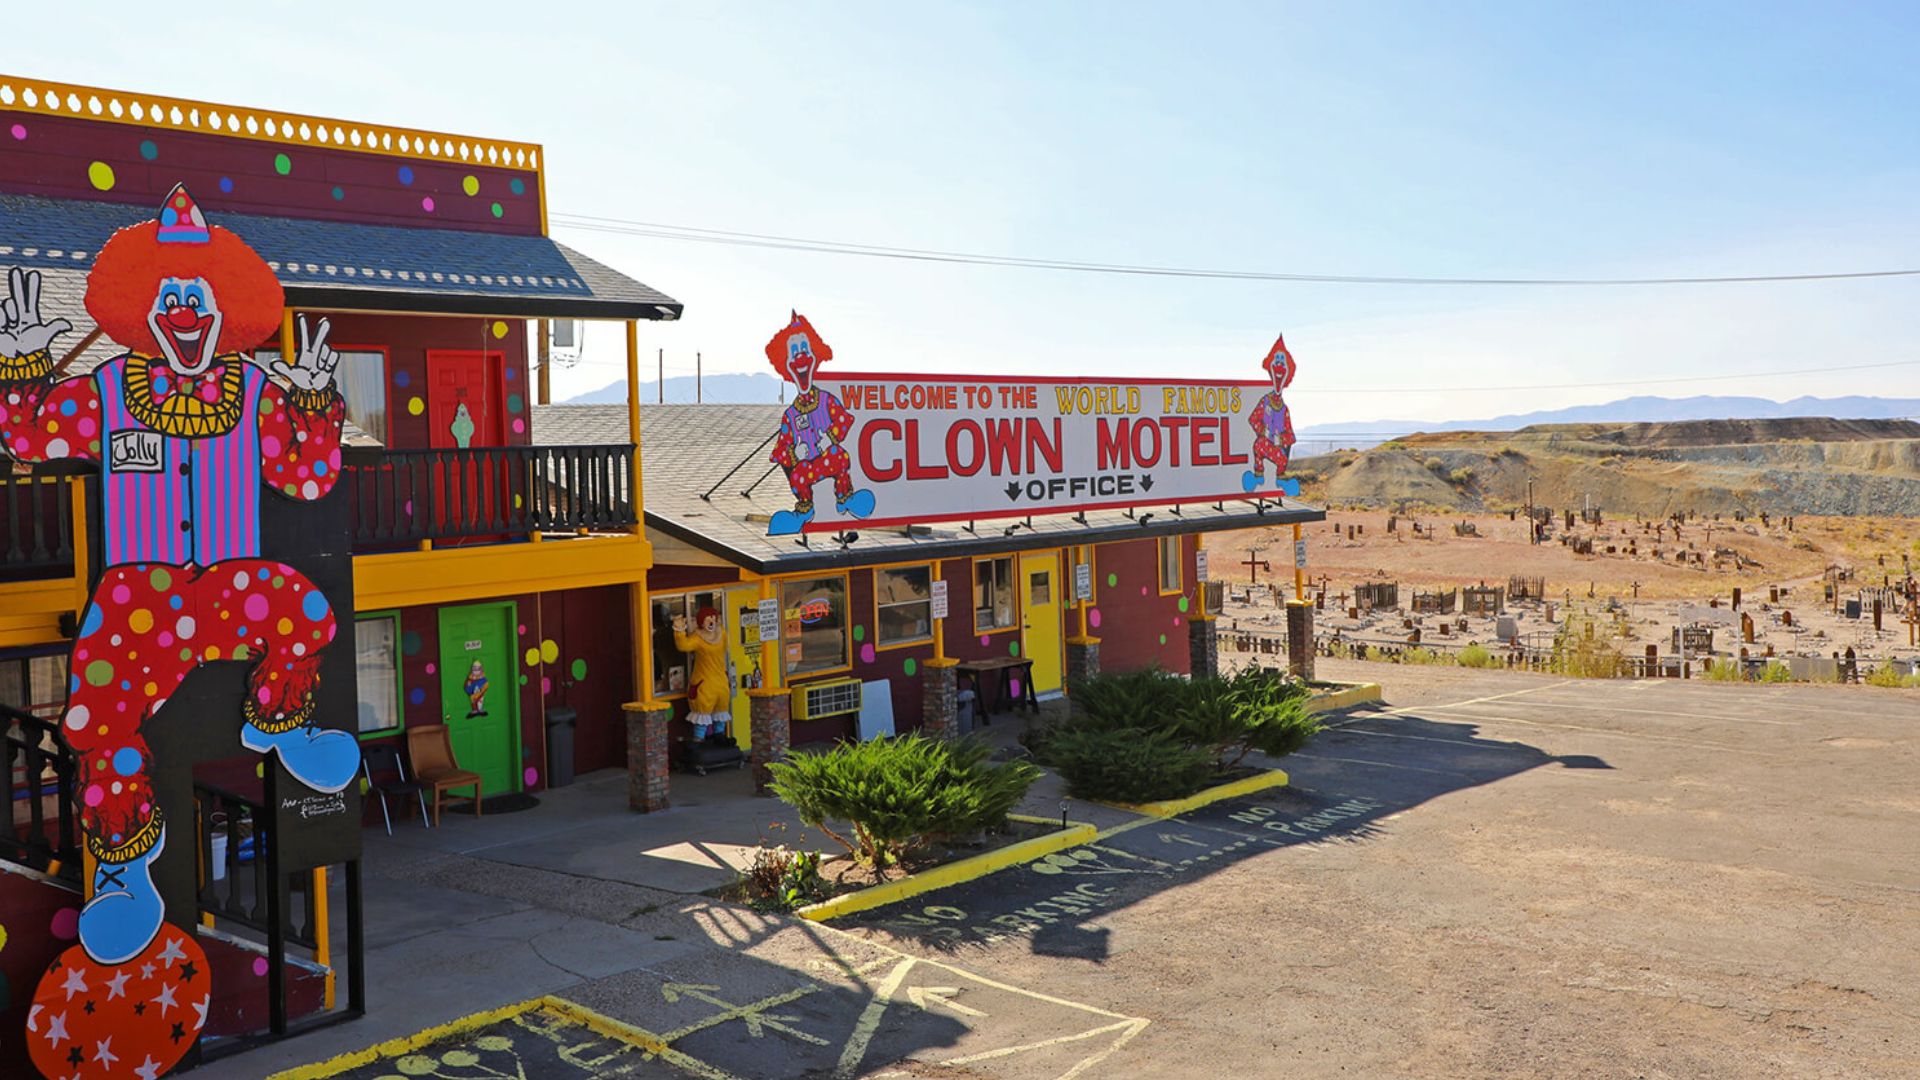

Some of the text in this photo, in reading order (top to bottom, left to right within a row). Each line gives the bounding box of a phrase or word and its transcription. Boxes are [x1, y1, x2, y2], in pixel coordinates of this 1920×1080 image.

[840, 384, 1242, 415] WELCOME TO THE WORLD FAMOUS
[112, 432, 159, 468] Jolly
[857, 416, 1249, 483] CLOWN MOTEL
[1026, 475, 1135, 501] OFFICE
[799, 603, 829, 620] OPEN
[1228, 806, 1277, 824] NO
